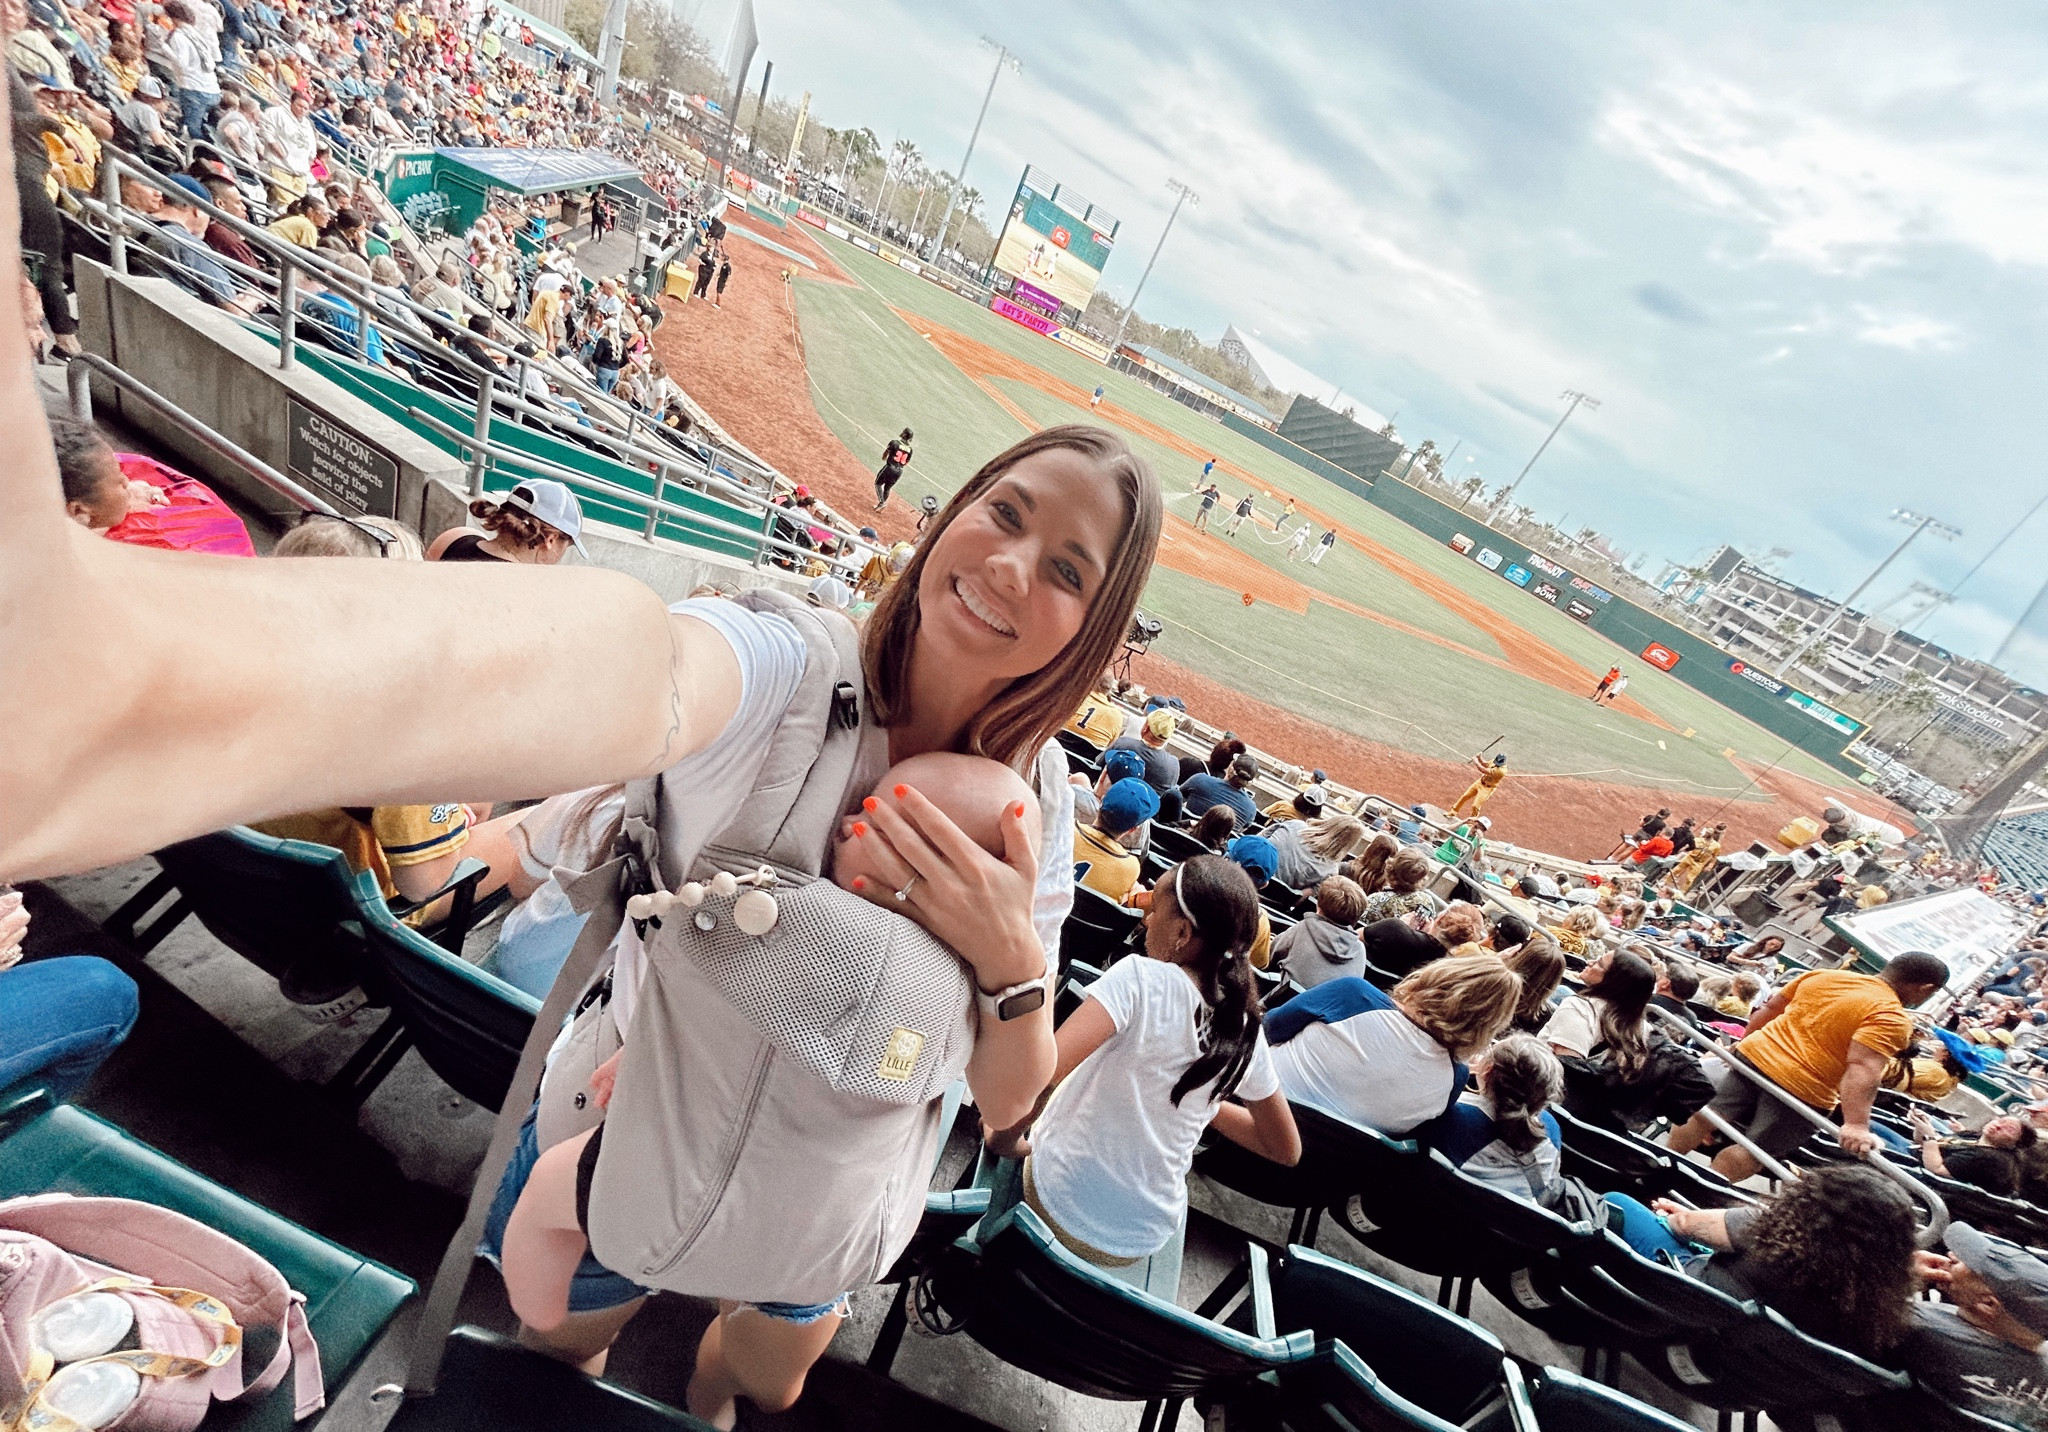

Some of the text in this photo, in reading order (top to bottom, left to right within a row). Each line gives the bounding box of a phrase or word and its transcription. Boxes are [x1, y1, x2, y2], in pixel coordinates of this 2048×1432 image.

[1002, 302, 1049, 332] LET'S PARTY!
[310, 417, 373, 466] CAUTION:
[299, 427, 383, 488] Watch for objects
[313, 451, 368, 494] leaving the
[311, 466, 368, 511] field of play
[1527, 553, 1547, 569] FIND
[1547, 563, 1566, 580] JOY
[1534, 586, 1558, 603] BOWL
[1077, 707, 1095, 729] 1
[1956, 698, 2004, 728] Stadium
[886, 1056, 912, 1071] LILLE
